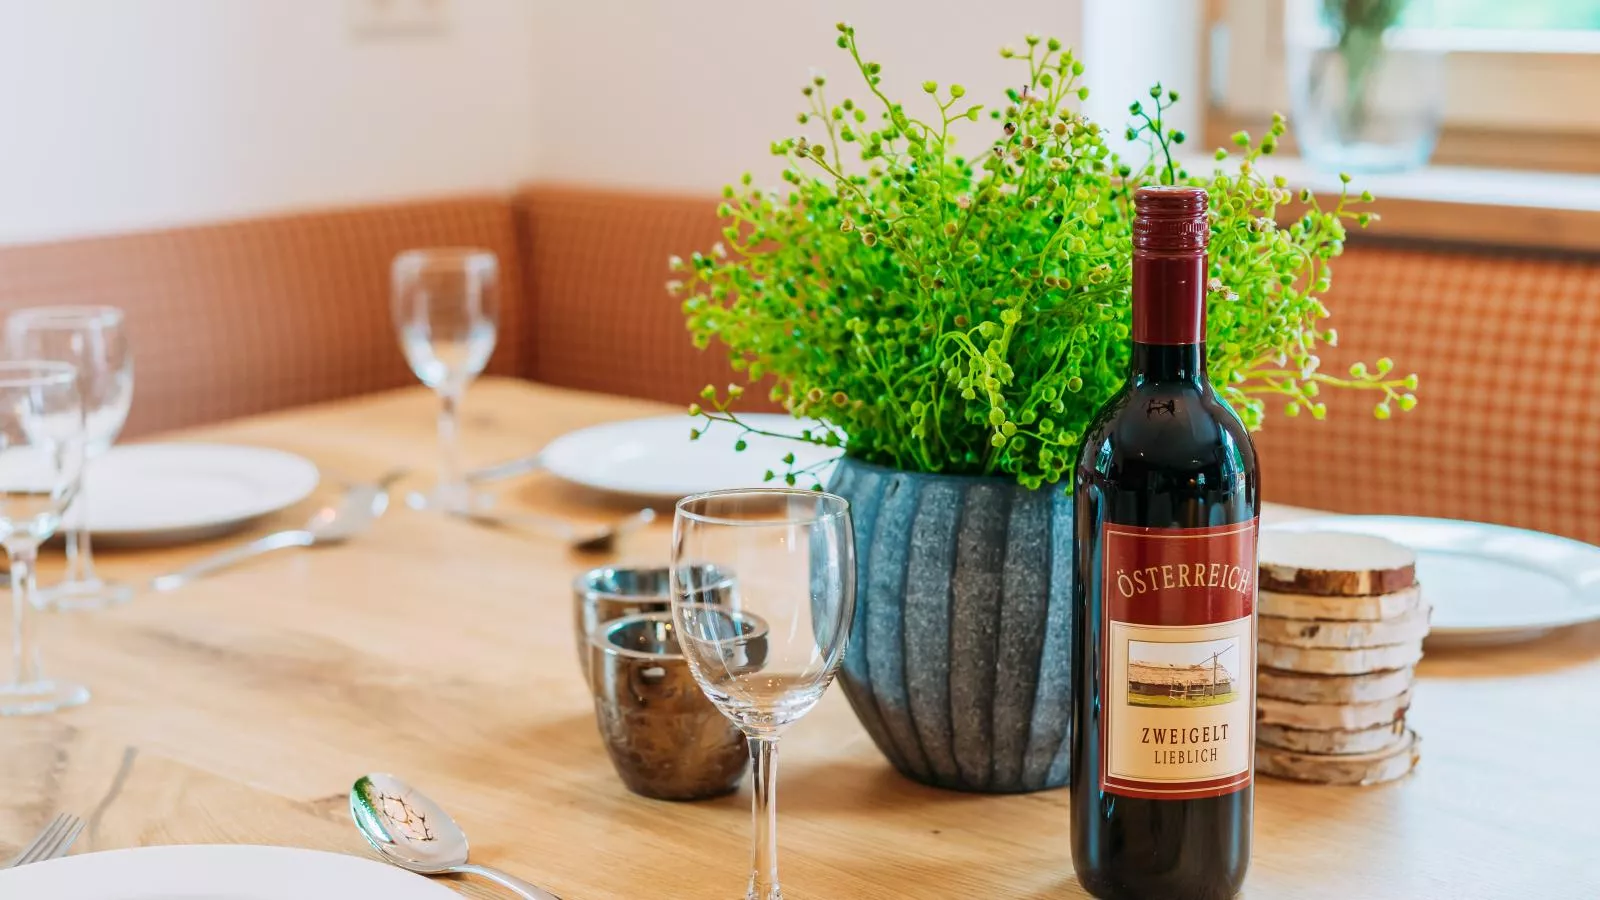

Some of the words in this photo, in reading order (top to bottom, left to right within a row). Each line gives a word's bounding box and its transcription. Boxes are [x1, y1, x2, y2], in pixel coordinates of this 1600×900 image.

[1116, 563, 1250, 598] ÖSTERREICH
[1141, 724, 1228, 744] ZWEIGELT
[1154, 748, 1217, 764] LIEBLICH
